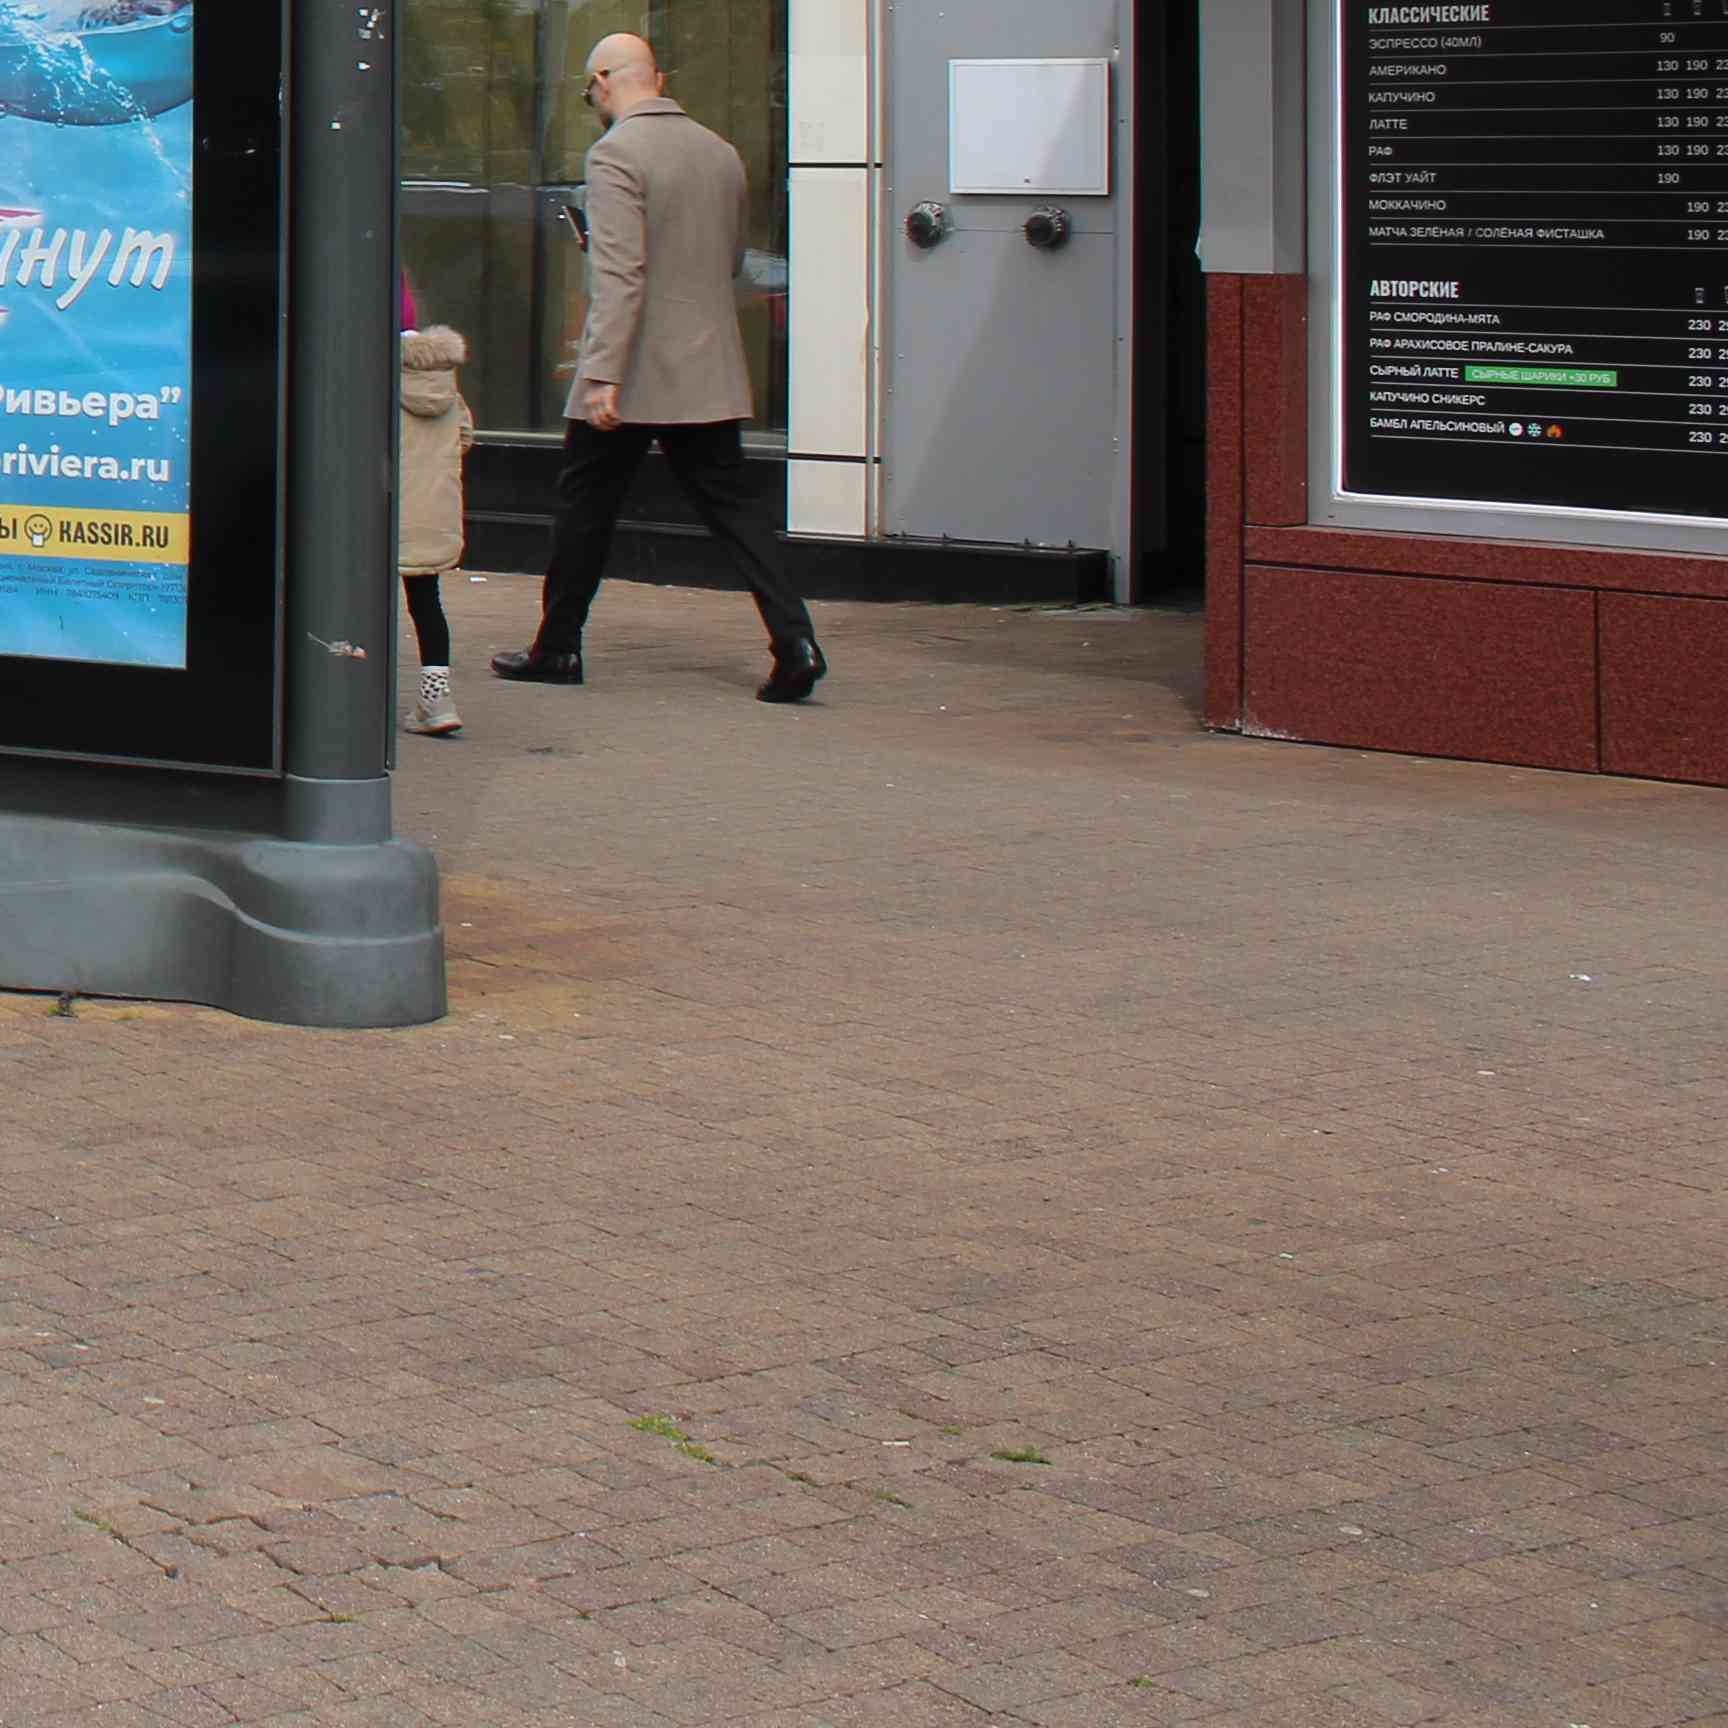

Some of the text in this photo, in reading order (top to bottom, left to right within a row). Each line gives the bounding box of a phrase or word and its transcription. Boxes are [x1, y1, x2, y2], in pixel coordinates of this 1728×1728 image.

[1368, 4, 1490, 25] КЛАССИЧЕСКИЕ
[1369, 37, 1438, 49] ЭСПРЕССО
[1659, 32, 1676, 43] 90
[1369, 63, 1447, 76] АМЕРИКАНО
[1656, 59, 1708, 72] 130 190
[1368, 91, 1435, 104] КАПУЧИНО
[1656, 88, 1708, 100] 130 190
[1369, 118, 1408, 130] ЛАТТЕ
[1656, 116, 1708, 128] 130 190
[1368, 145, 1393, 157] РАФ
[1657, 144, 1709, 156] 130 190
[1369, 170, 1437, 184] ФЛЭТ УАЙТ
[1657, 172, 1680, 184] 190
[1368, 199, 1447, 212] МОККАЧИНО
[1687, 201, 1709, 213] 190
[1368, 226, 1407, 238] МАТЧА
[1535, 227, 1605, 240] ФИСТАШКА
[1687, 229, 1709, 241] 190
[1370, 279, 1460, 299] АВТОРСКИЕ
[1369, 311, 1501, 325] РАФ СМОРОДИНА-МЯТА
[1688, 319, 1712, 331] 230
[1369, 337, 1574, 355] РАФ АРАХИСОВОЕ ПРАЛИНЕ-САКУРА
[1688, 347, 1712, 360] 230
[1369, 363, 1420, 377] СЫРНЫЙ
[1422, 366, 1459, 379] ЛАТТЕ
[1688, 375, 1712, 387] 230
[1369, 391, 1486, 406] КАПУЧИНО СНИКЕРС
[1688, 403, 1712, 415] 230
[1369, 417, 1505, 434] БАМБЛ АПЕЛЬСИНОВЫЙ
[1688, 431, 1713, 443] 230
[58, 518, 170, 551] KASSIR.RU
